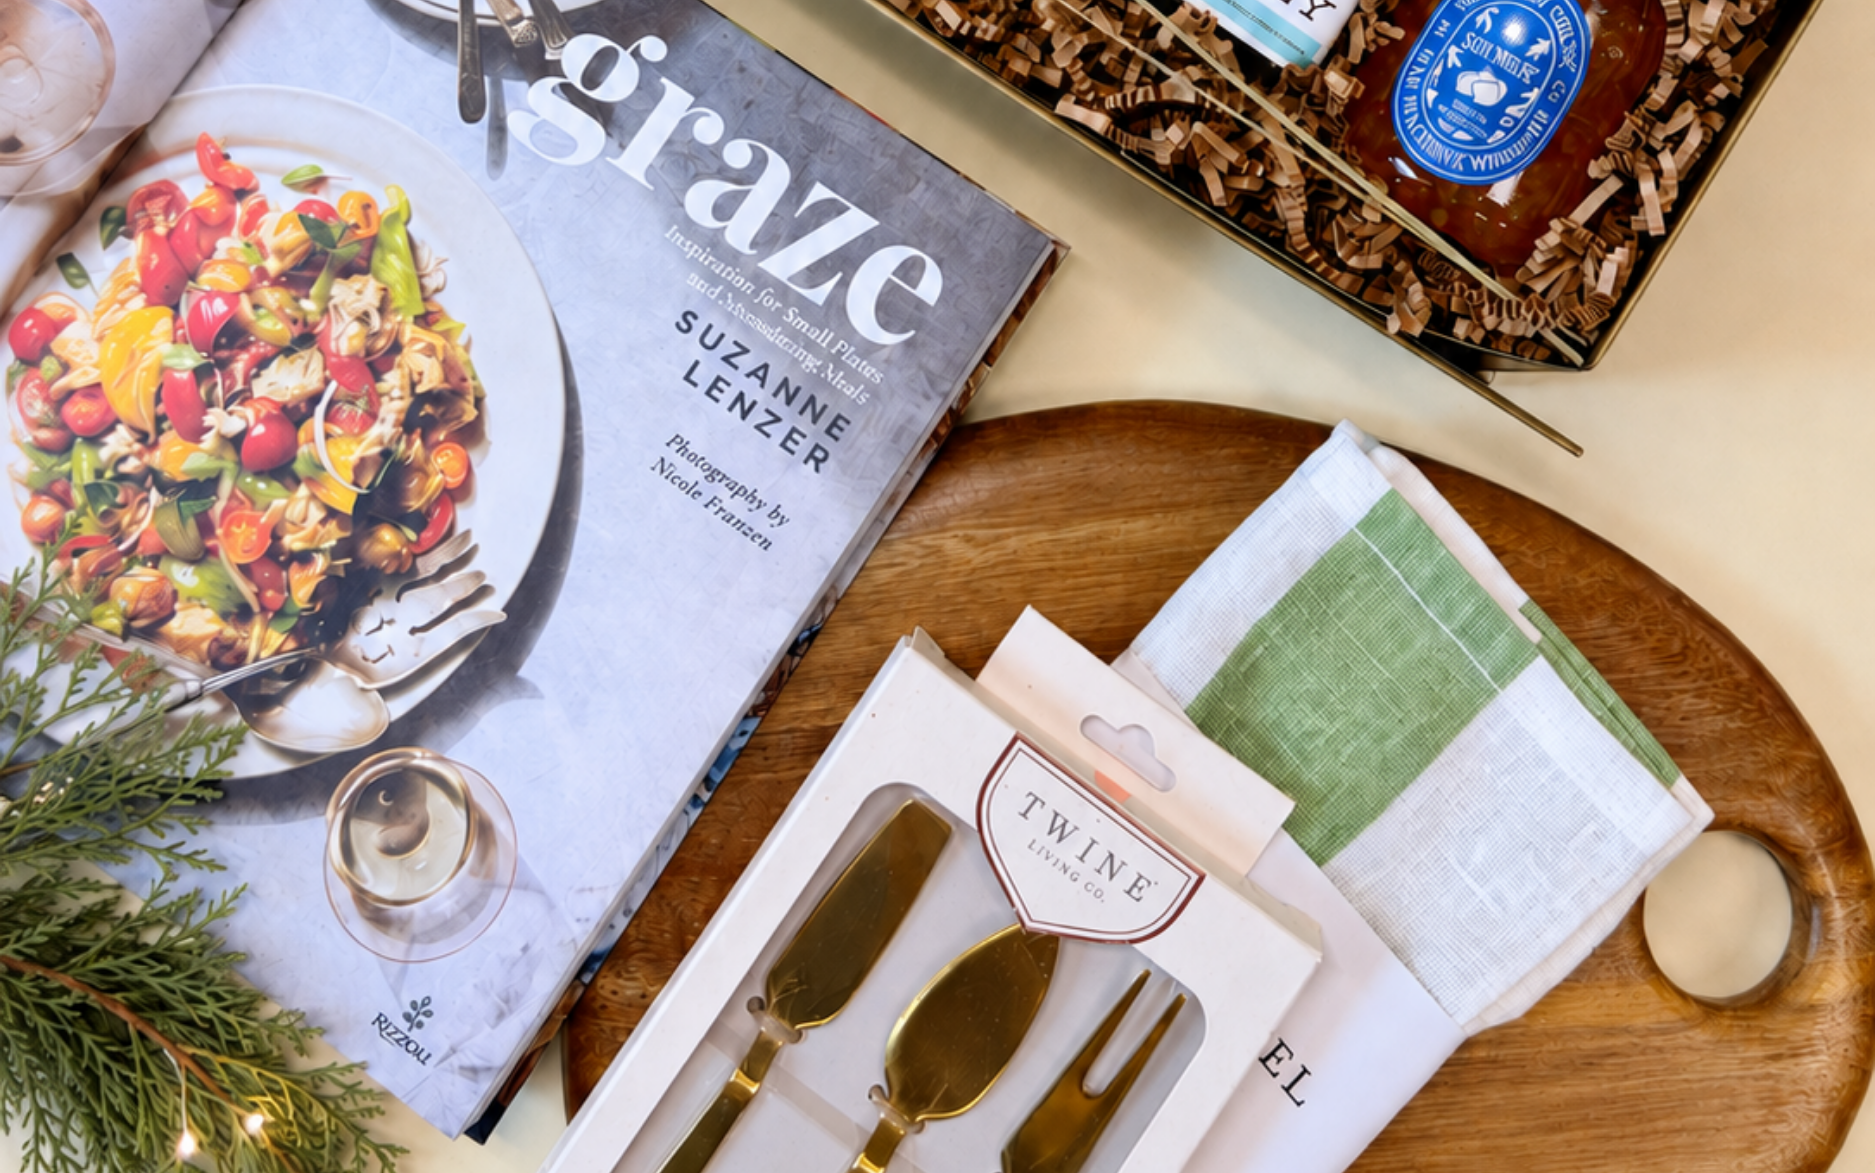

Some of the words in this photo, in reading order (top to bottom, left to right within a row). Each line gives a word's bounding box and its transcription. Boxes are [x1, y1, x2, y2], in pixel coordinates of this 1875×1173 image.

[506, 32, 943, 346] graze
[664, 225, 753, 295] Inspiration
[753, 287, 782, 313] for
[782, 306, 834, 348] Small
[675, 310, 850, 441] SUZANNE
[682, 359, 829, 474] LENZER
[650, 456, 703, 501] Nicole
[703, 495, 773, 551] Franzen
[665, 434, 767, 512] Photography
[767, 504, 790, 528] by
[1017, 791, 1153, 902] TWINE
[1026, 839, 1081, 883] LIVING
[1258, 1037, 1312, 1108] EL
